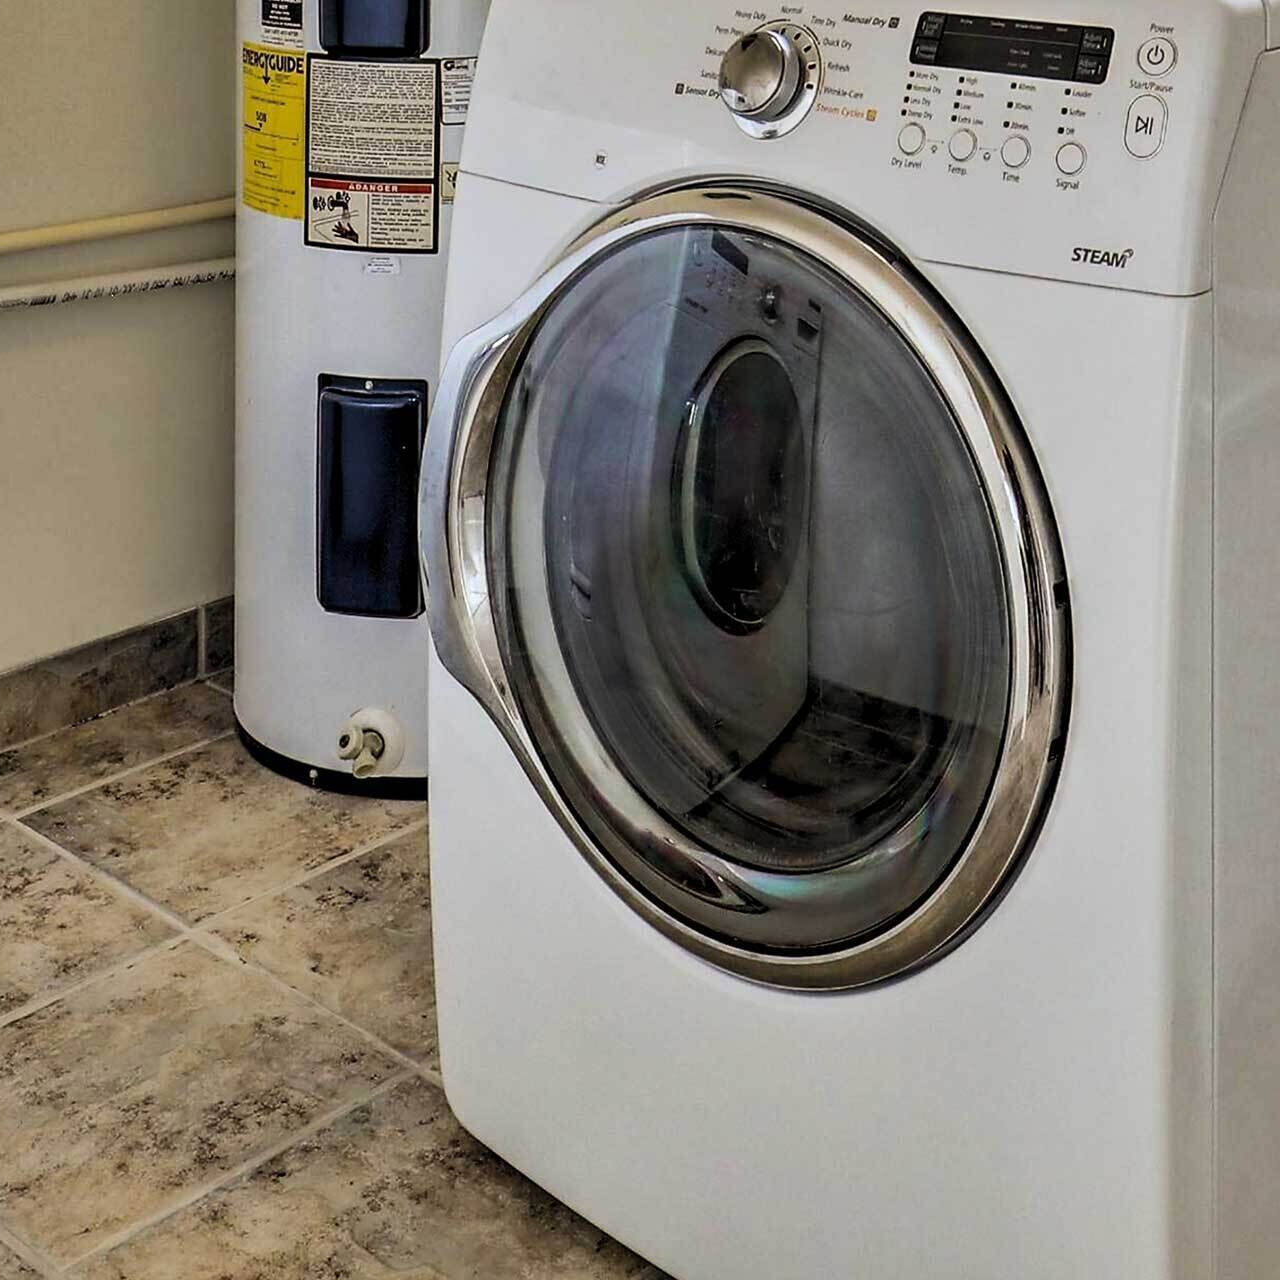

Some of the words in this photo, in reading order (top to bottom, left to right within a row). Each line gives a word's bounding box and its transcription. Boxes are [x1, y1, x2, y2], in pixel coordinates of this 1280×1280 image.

[824, 17, 836, 28] Dry
[843, 14, 872, 25] Manual
[873, 17, 887, 28] Dry
[1149, 23, 1174, 33] Power
[823, 38, 839, 48] Quick
[839, 40, 852, 50] Dry
[932, 86, 941, 95] Dry
[1129, 79, 1174, 93] Start/Pause
[684, 86, 707, 98] Sensor
[708, 88, 721, 100] Dry
[922, 98, 931, 107] Dry
[816, 103, 841, 116] Steam
[841, 106, 865, 119] Cycles
[924, 111, 933, 120] Dry
[891, 157, 903, 169] Dry
[904, 159, 922, 169] Level
[1002, 171, 1020, 183] Time
[355, 183, 399, 193] DANGER
[1056, 178, 1080, 191] Signal
[1071, 247, 1126, 269] STEAM
